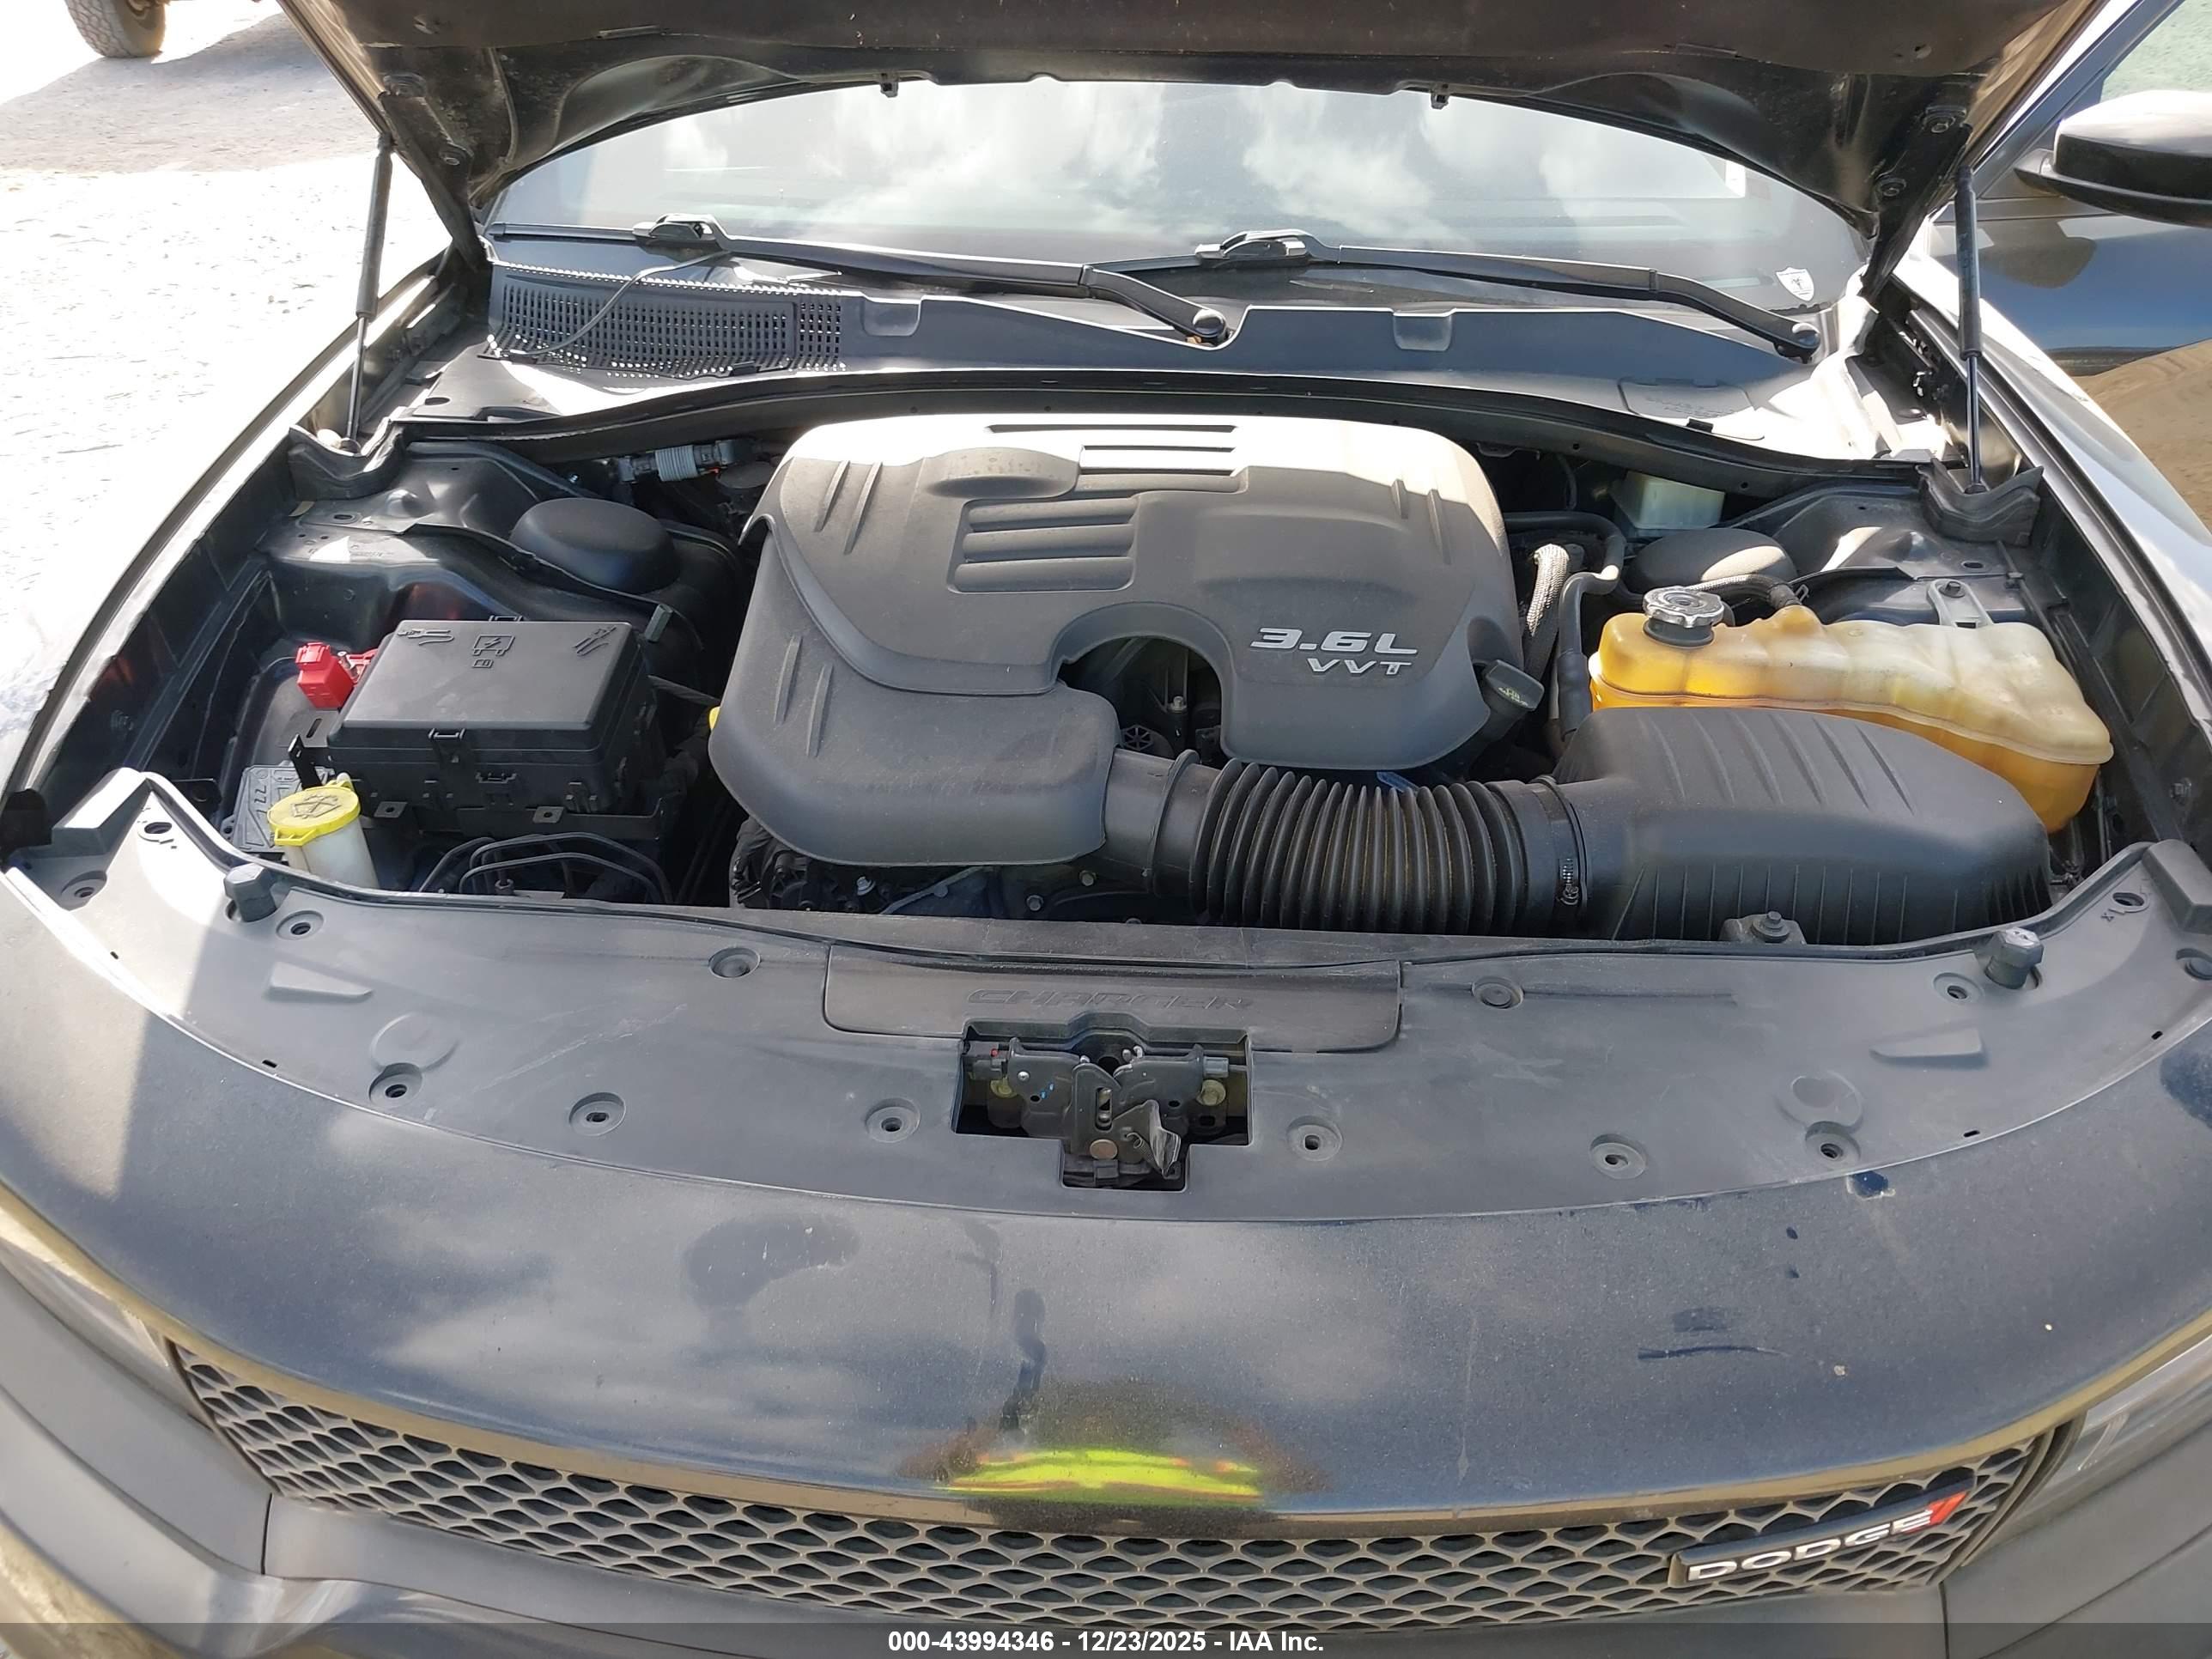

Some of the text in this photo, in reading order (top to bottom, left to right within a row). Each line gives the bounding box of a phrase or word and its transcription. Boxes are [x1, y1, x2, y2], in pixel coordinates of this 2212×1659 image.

[1249, 627, 1418, 655] 3.6L
[1306, 657, 1413, 677] VVT
[1687, 1508, 1935, 1582] DODGE
